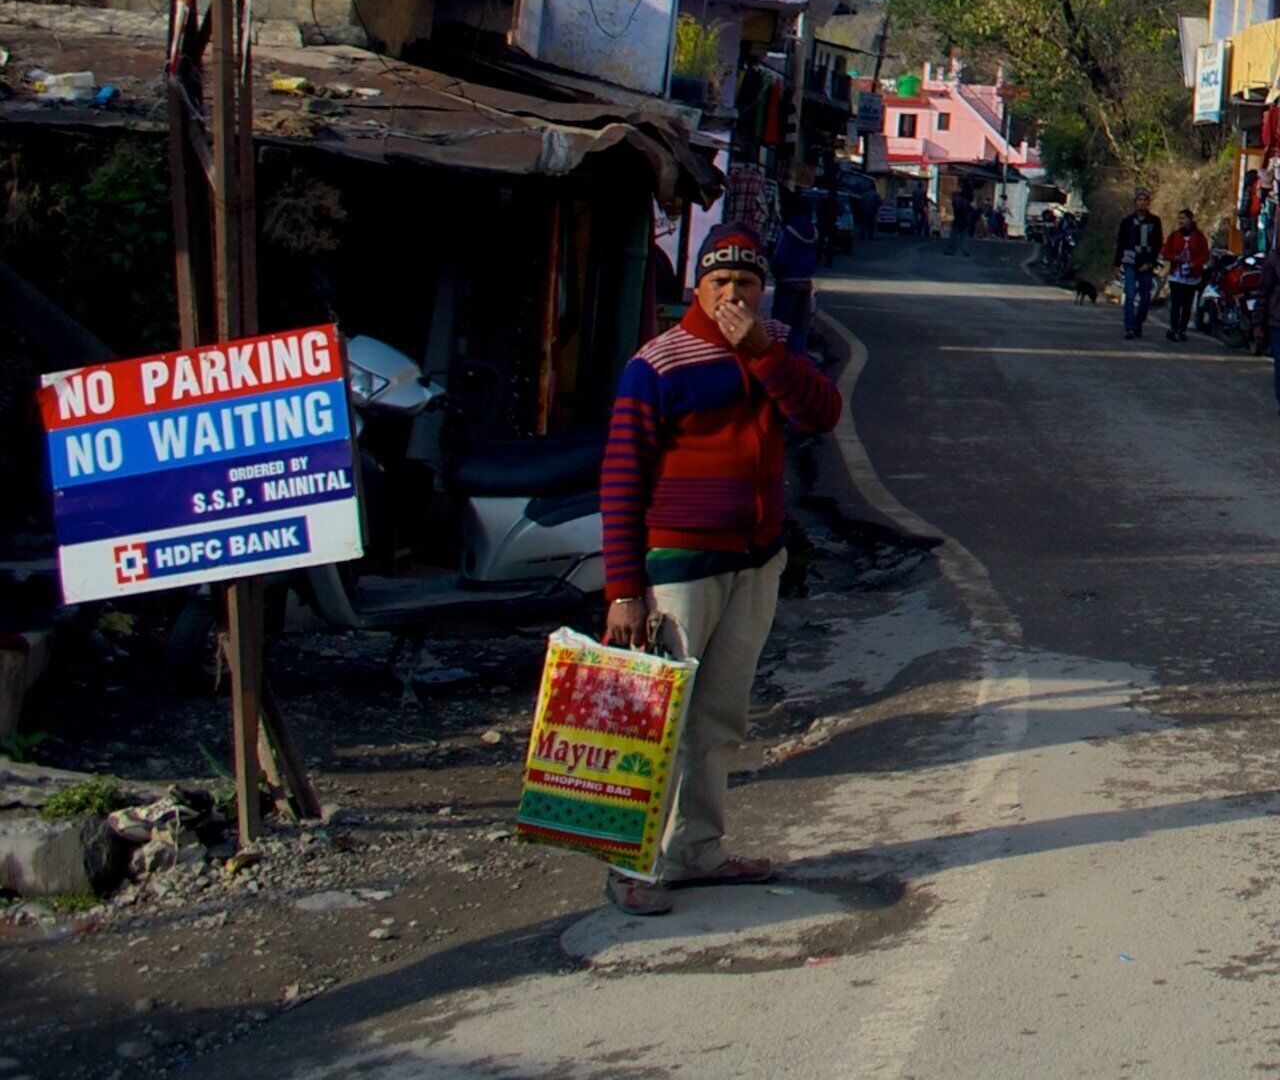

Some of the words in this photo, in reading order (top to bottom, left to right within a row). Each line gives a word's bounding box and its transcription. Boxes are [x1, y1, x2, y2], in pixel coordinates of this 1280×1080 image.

[59, 369, 116, 421] NO
[140, 330, 332, 406] PARKING
[65, 428, 123, 477] NO
[148, 390, 334, 462] WAITING
[193, 487, 252, 514] S.S.P.
[264, 469, 351, 502] NAINITAL
[229, 460, 285, 482] ORDERED
[291, 457, 308, 471] BY
[155, 541, 223, 568] HDFC
[230, 526, 300, 556] BANK
[534, 729, 618, 774] Mayur
[543, 774, 602, 792] SHOPPING
[606, 784, 632, 797] BAG
